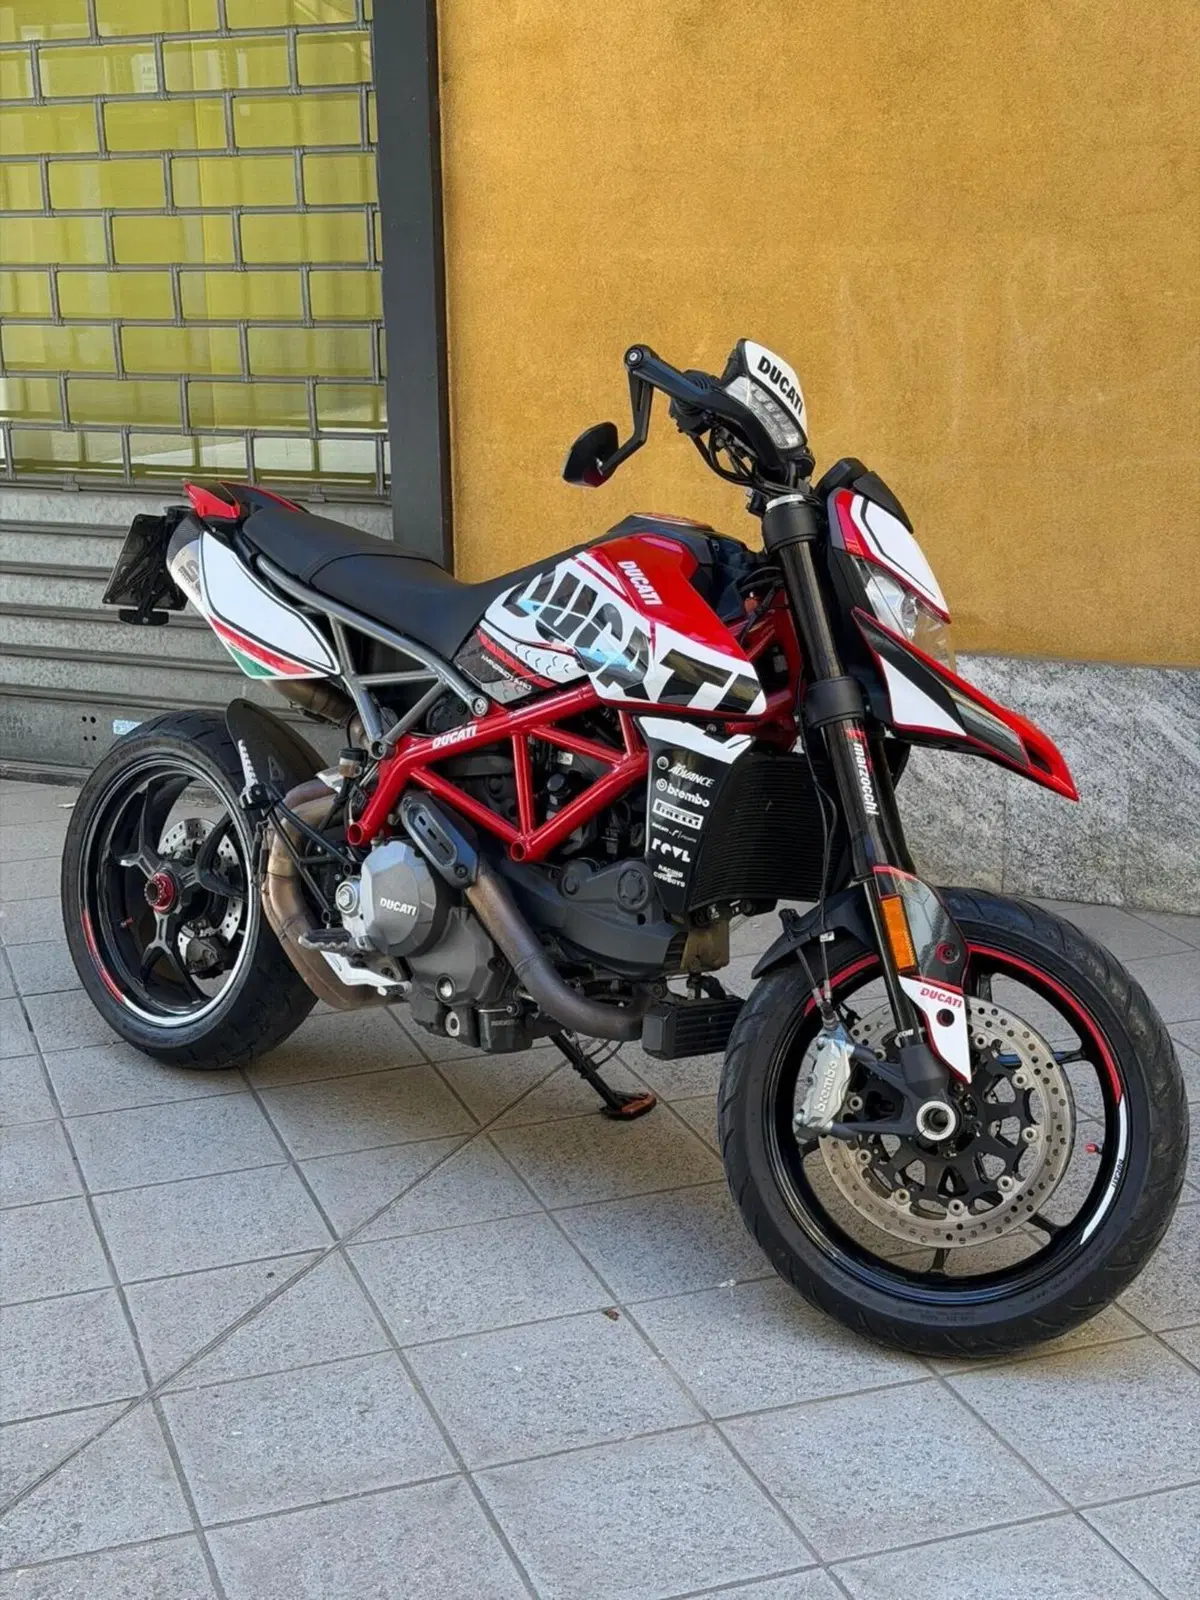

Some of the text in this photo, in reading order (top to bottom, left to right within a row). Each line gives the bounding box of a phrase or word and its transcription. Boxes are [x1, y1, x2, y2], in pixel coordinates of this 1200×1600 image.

[757, 355, 803, 416] DUCATI
[617, 561, 663, 605] DUCATI
[432, 725, 478, 749] DUCATI
[668, 765, 715, 787] ADVANCE
[853, 742, 879, 815] marzocchi
[667, 783, 710, 808] brembo
[380, 898, 417, 916] DUCATI
[920, 987, 962, 1008] DUCATI
[814, 1061, 838, 1112] brembo
